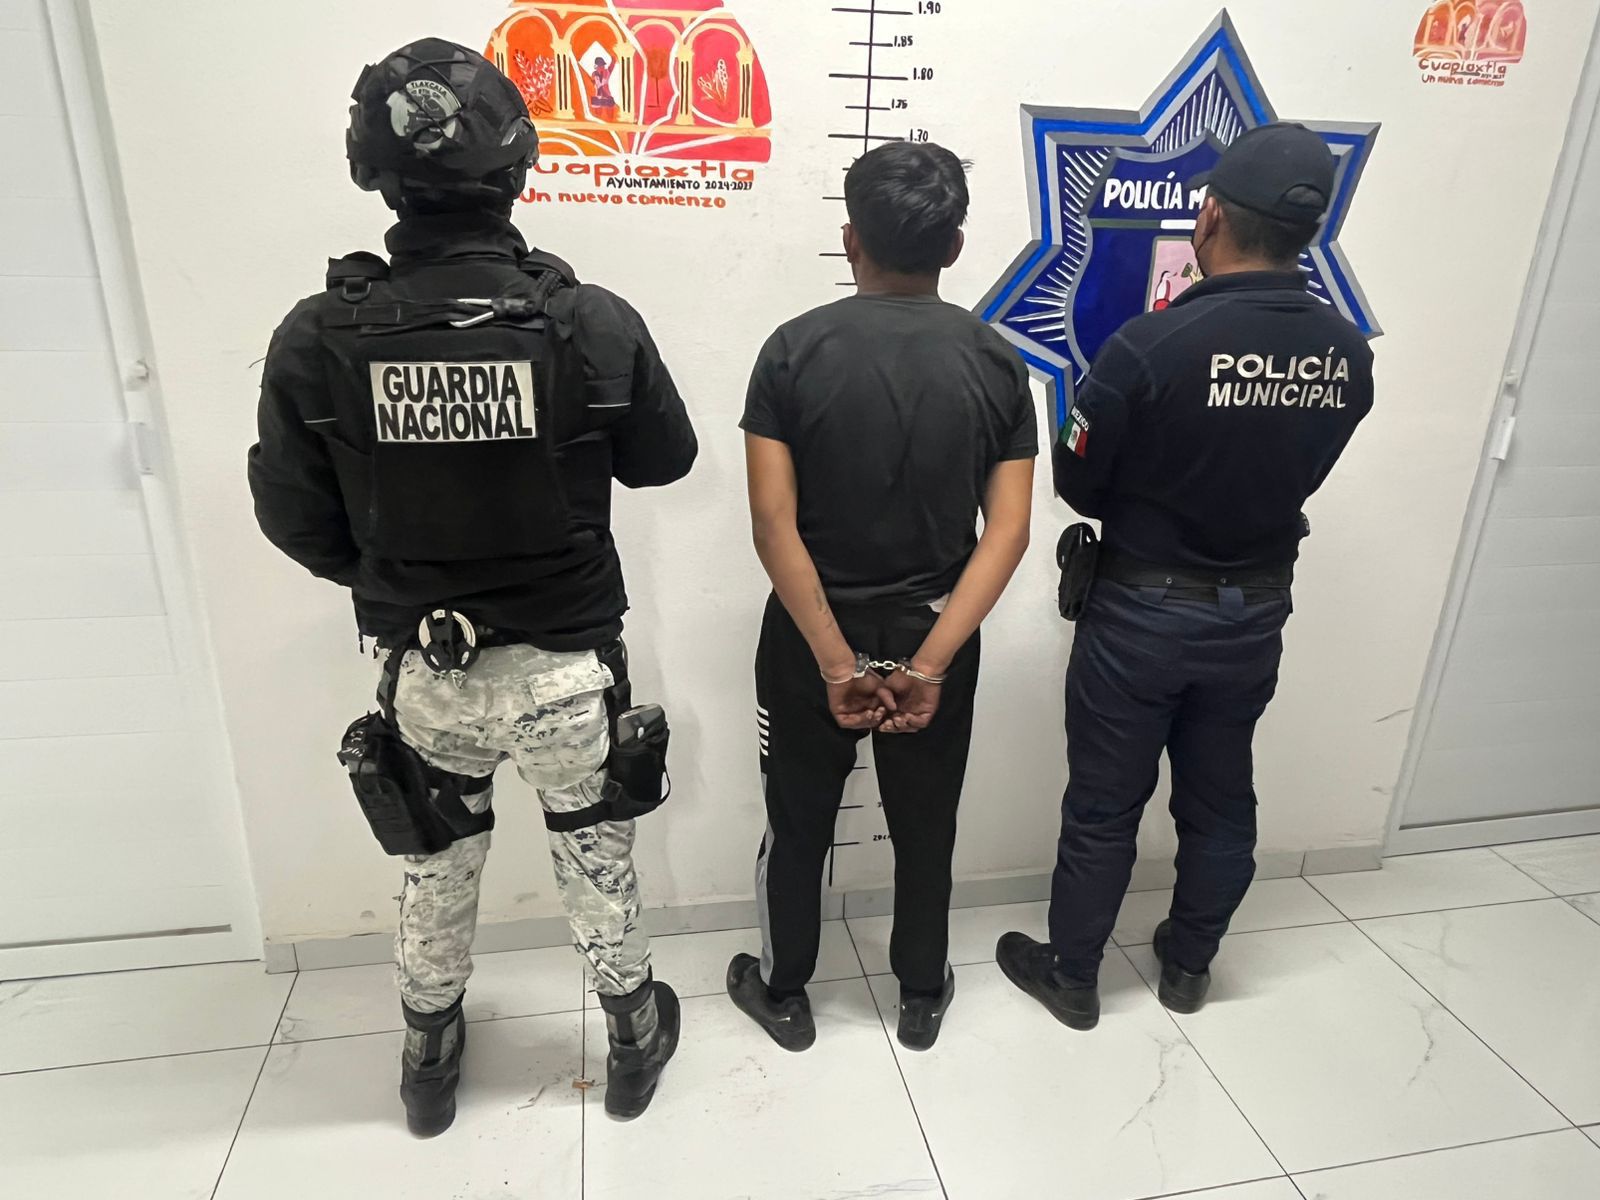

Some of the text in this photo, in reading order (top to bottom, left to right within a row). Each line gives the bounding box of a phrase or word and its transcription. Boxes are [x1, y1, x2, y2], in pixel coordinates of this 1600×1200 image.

[918, 0, 941, 15] 1.90
[893, 35, 914, 47] 1.85
[912, 67, 934, 81] 1.80
[1418, 58, 1507, 76] Cuapiaxtla
[410, 81, 447, 97] TLAXCALA
[909, 129, 929, 142] 1.70
[533, 159, 755, 188] uapiaxtla
[606, 176, 701, 191] AYUNTAMIENTO
[520, 187, 726, 209] Un nuevo comienzo
[1102, 171, 1183, 210] POLICÍA
[1210, 346, 1349, 382] POLICÍA
[382, 364, 522, 404] GUARDIA
[1207, 382, 1347, 408] MUNICIPAL
[378, 401, 533, 441] NACIONAL
